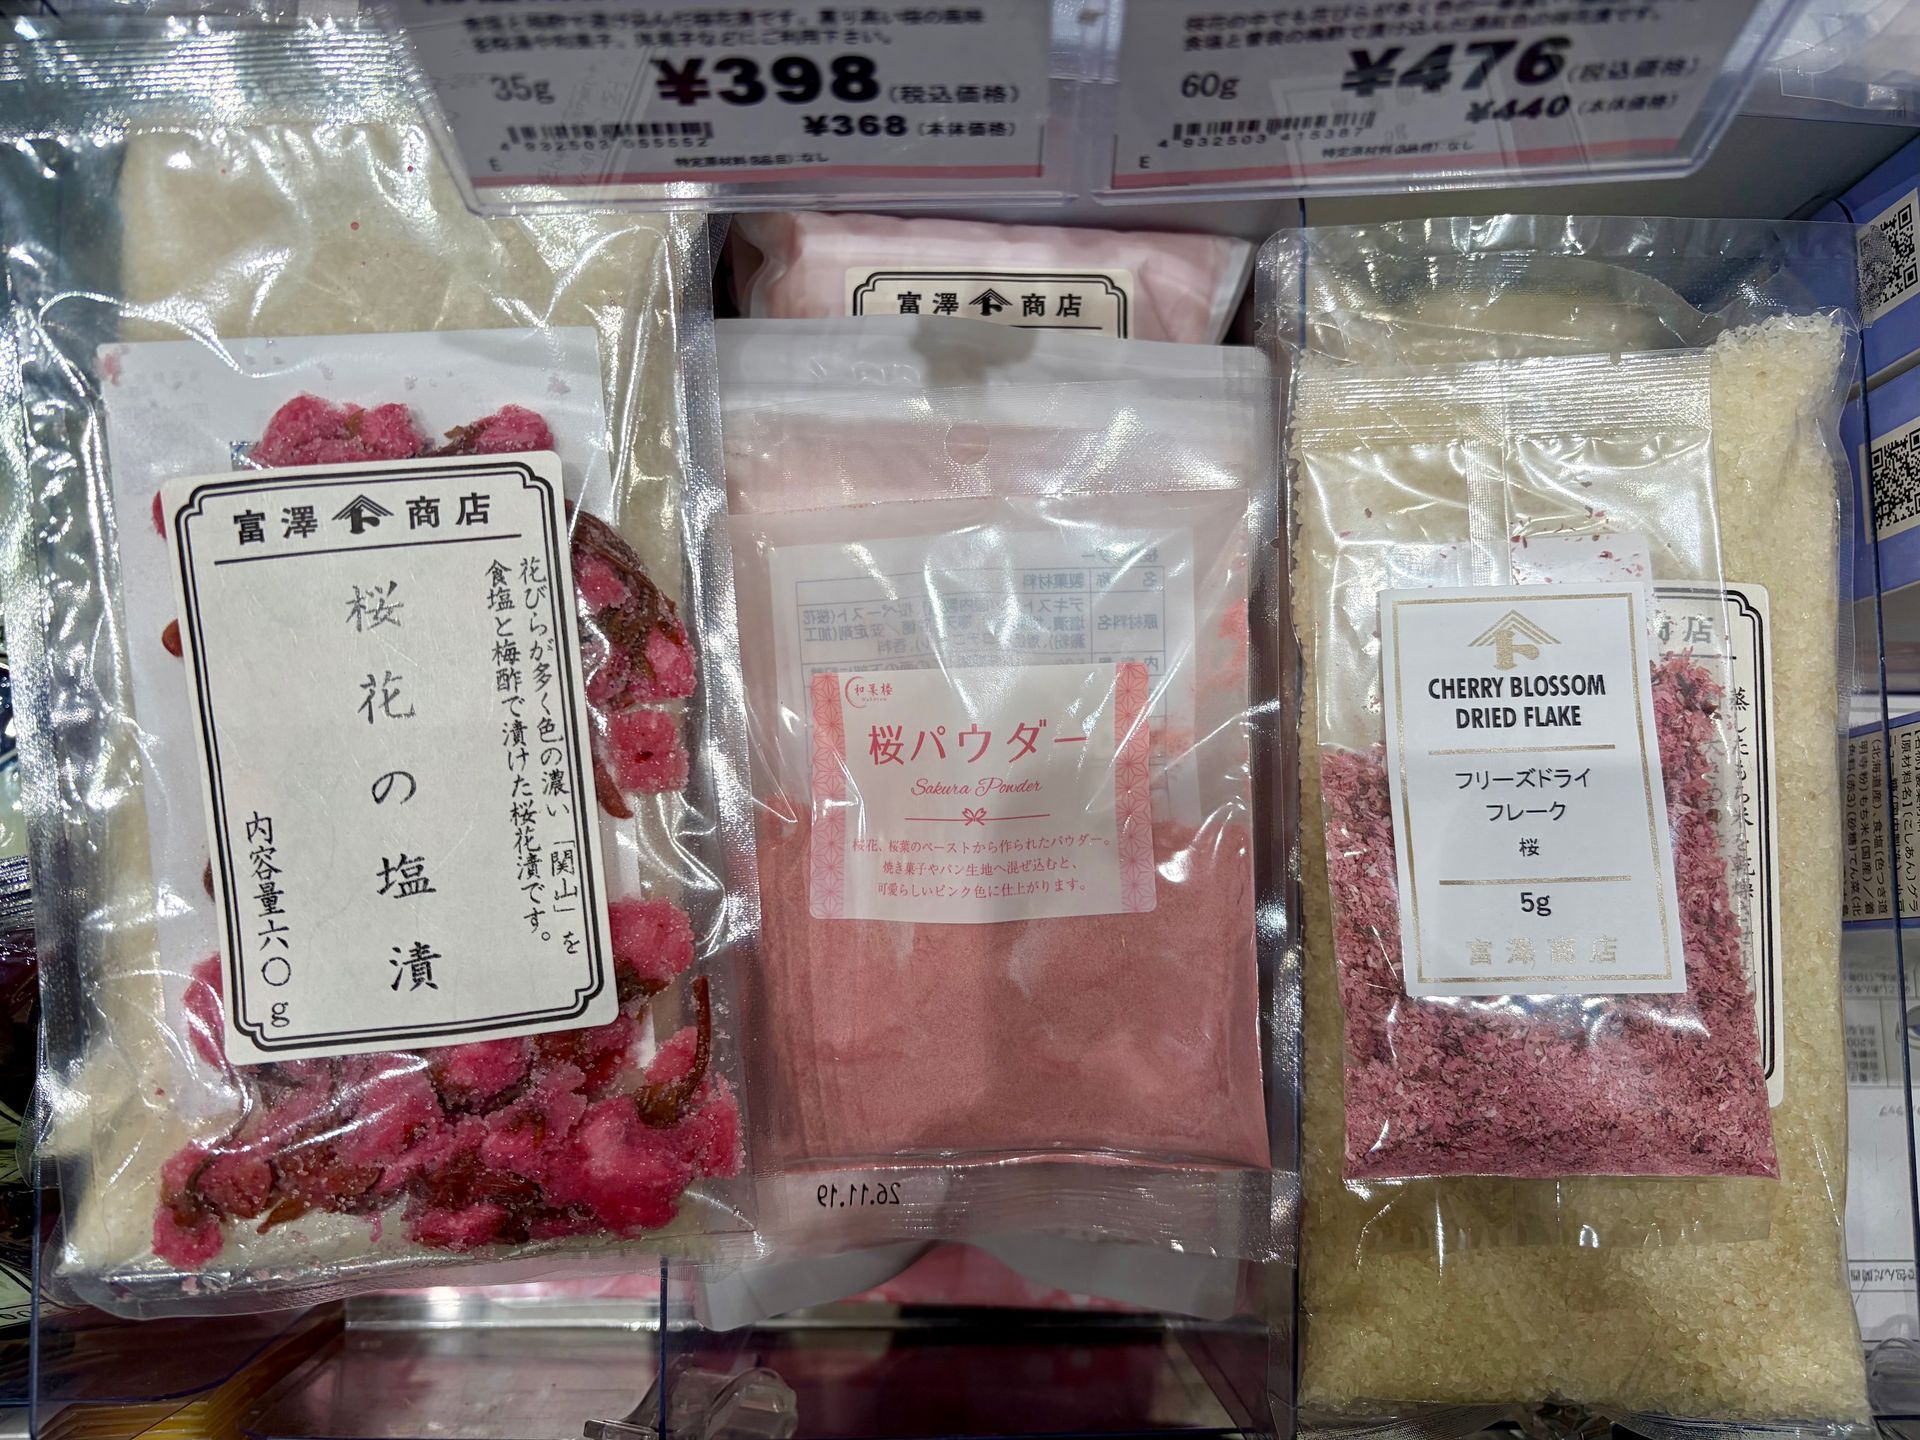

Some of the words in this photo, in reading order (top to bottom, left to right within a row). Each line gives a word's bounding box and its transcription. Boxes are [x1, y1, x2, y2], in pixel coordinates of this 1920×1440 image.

[1341, 36, 1573, 97] ¥476
[490, 74, 556, 105] 35g
[654, 54, 880, 106] ¥398
[1181, 72, 1240, 100] 60g
[1465, 94, 1571, 124] ¥440
[803, 114, 908, 137] ¥368
[1428, 676, 1503, 700] CHERRY
[1510, 674, 1606, 697] BLOSSOM
[1455, 705, 1517, 729] DRIED
[1524, 704, 1582, 727] FLAKE
[485, 559, 552, 943] 食塩と梅酢で漬けた桜花漬です。
[868, 720, 1089, 767] 桜パウダー
[346, 580, 442, 993] 桜花の塩漬
[910, 777, 971, 796] Sakura
[976, 776, 1044, 796] Powder
[1455, 767, 1591, 790] フリーズドライ
[1486, 801, 1566, 822] フレーク
[851, 833, 1111, 855] 桜花、桜葉のペーストから作られたパウダー。
[1519, 837, 1540, 857] 桜
[877, 878, 1086, 899] 可愛らしいピンク色に仕上がります。
[1519, 891, 1552, 916] 5g
